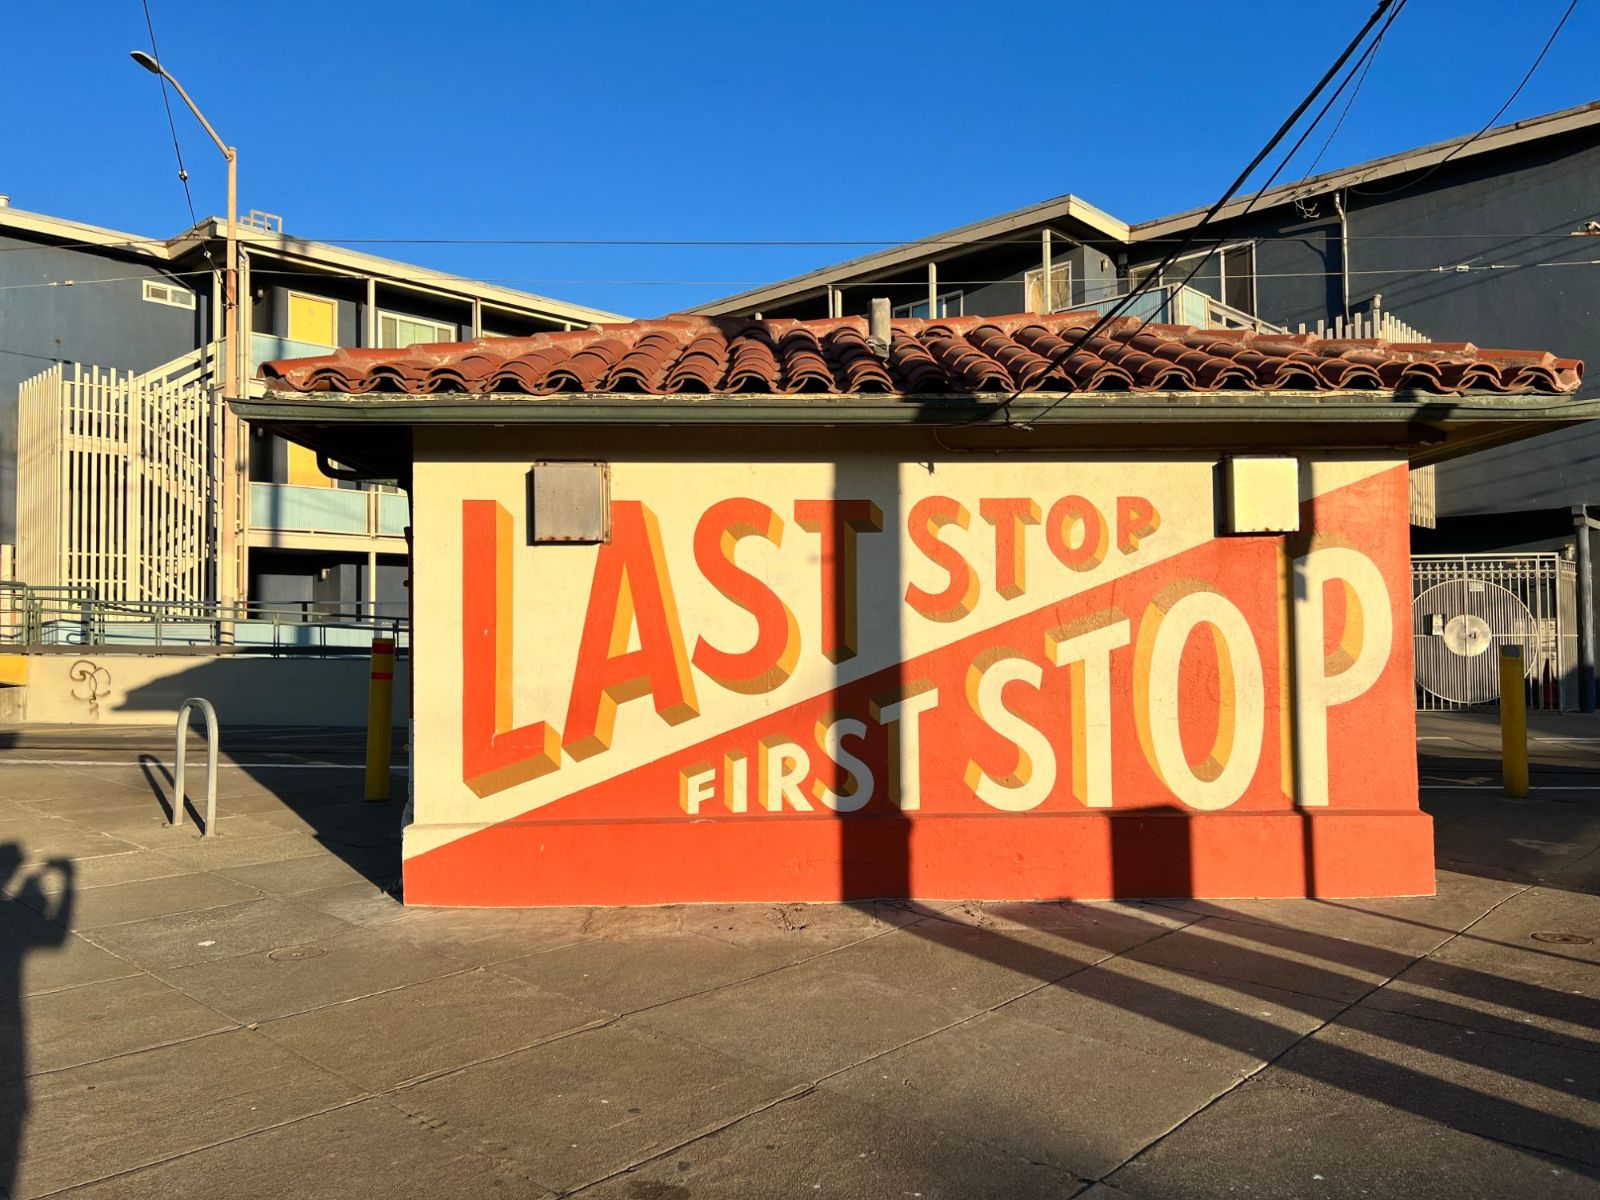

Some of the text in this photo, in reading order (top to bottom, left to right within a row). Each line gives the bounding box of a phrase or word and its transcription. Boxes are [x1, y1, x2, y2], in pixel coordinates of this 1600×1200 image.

[462, 494, 1161, 800] LAST STOP
[679, 532, 1394, 815] FIRST STOP
